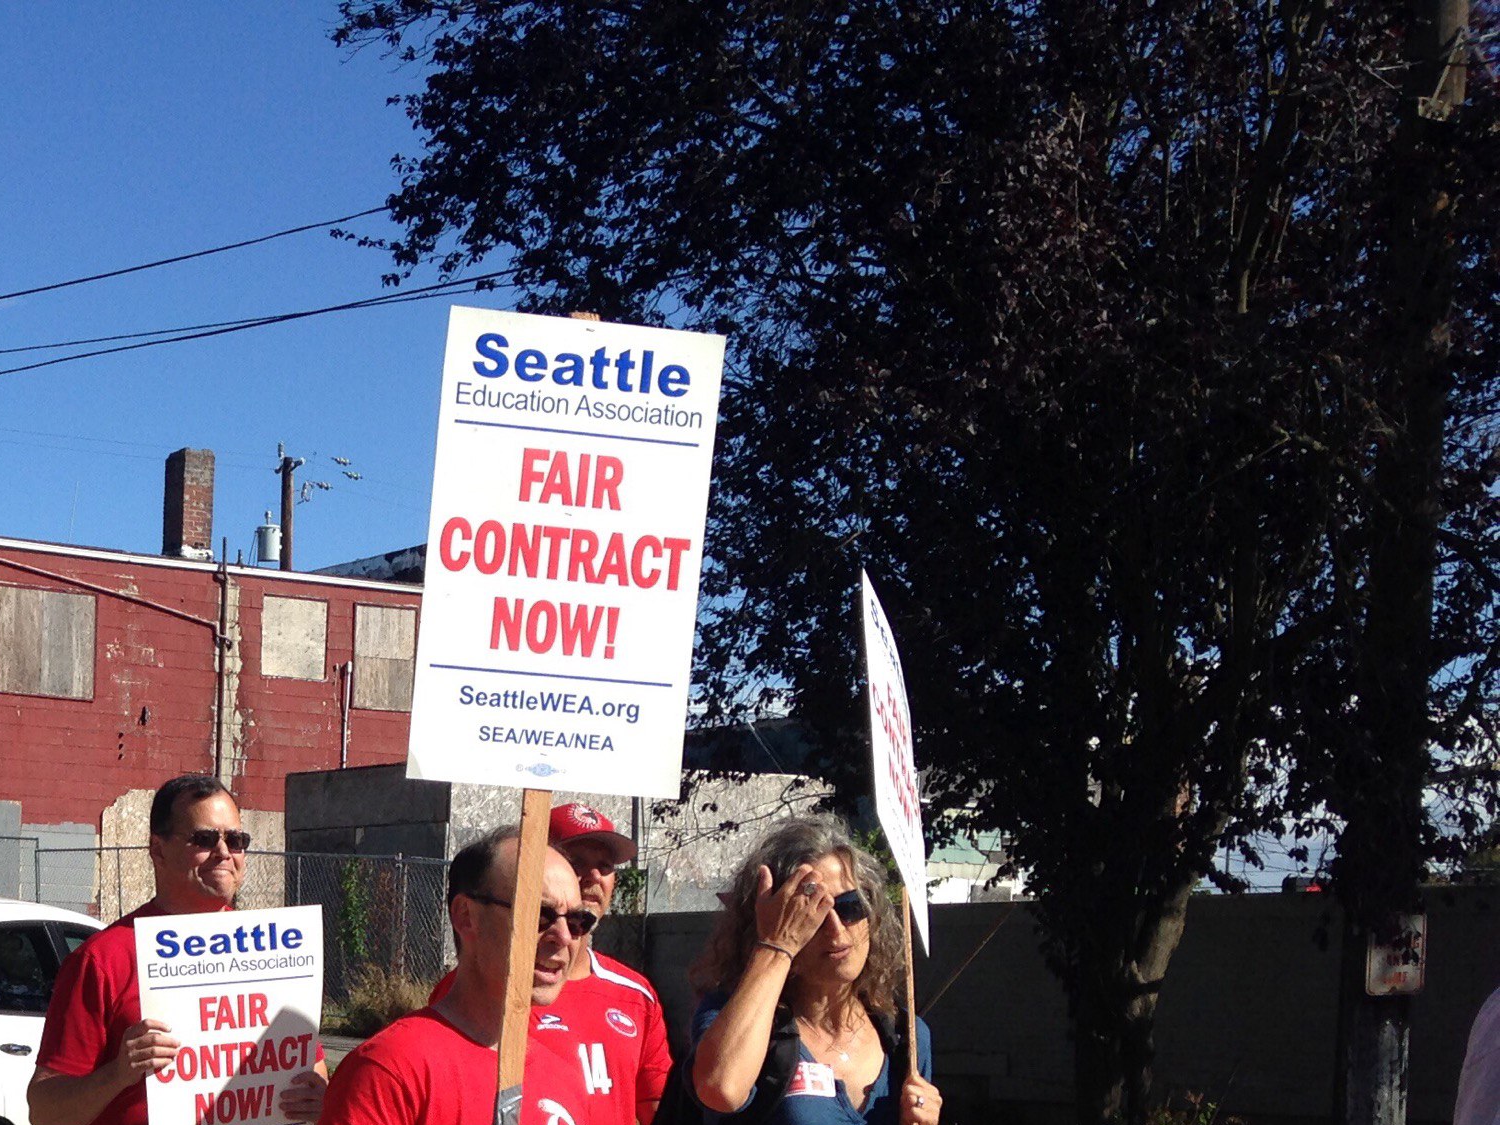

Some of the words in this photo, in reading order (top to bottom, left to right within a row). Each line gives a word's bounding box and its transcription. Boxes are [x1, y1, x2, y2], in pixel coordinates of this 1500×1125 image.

[473, 333, 690, 397] Seattle
[456, 382, 569, 415] Education
[575, 395, 702, 429] Association
[519, 448, 624, 511] FAIR
[440, 517, 691, 591] CONTRACT
[490, 597, 620, 659] NOW!
[459, 685, 640, 723] SeattleWEA.org
[479, 726, 614, 751] SEA/WEA/NEA
[155, 923, 303, 958] Seattle
[148, 959, 224, 978] Education
[229, 954, 314, 972] Association
[199, 993, 269, 1031] FAIR
[578, 1043, 612, 1095] 14
